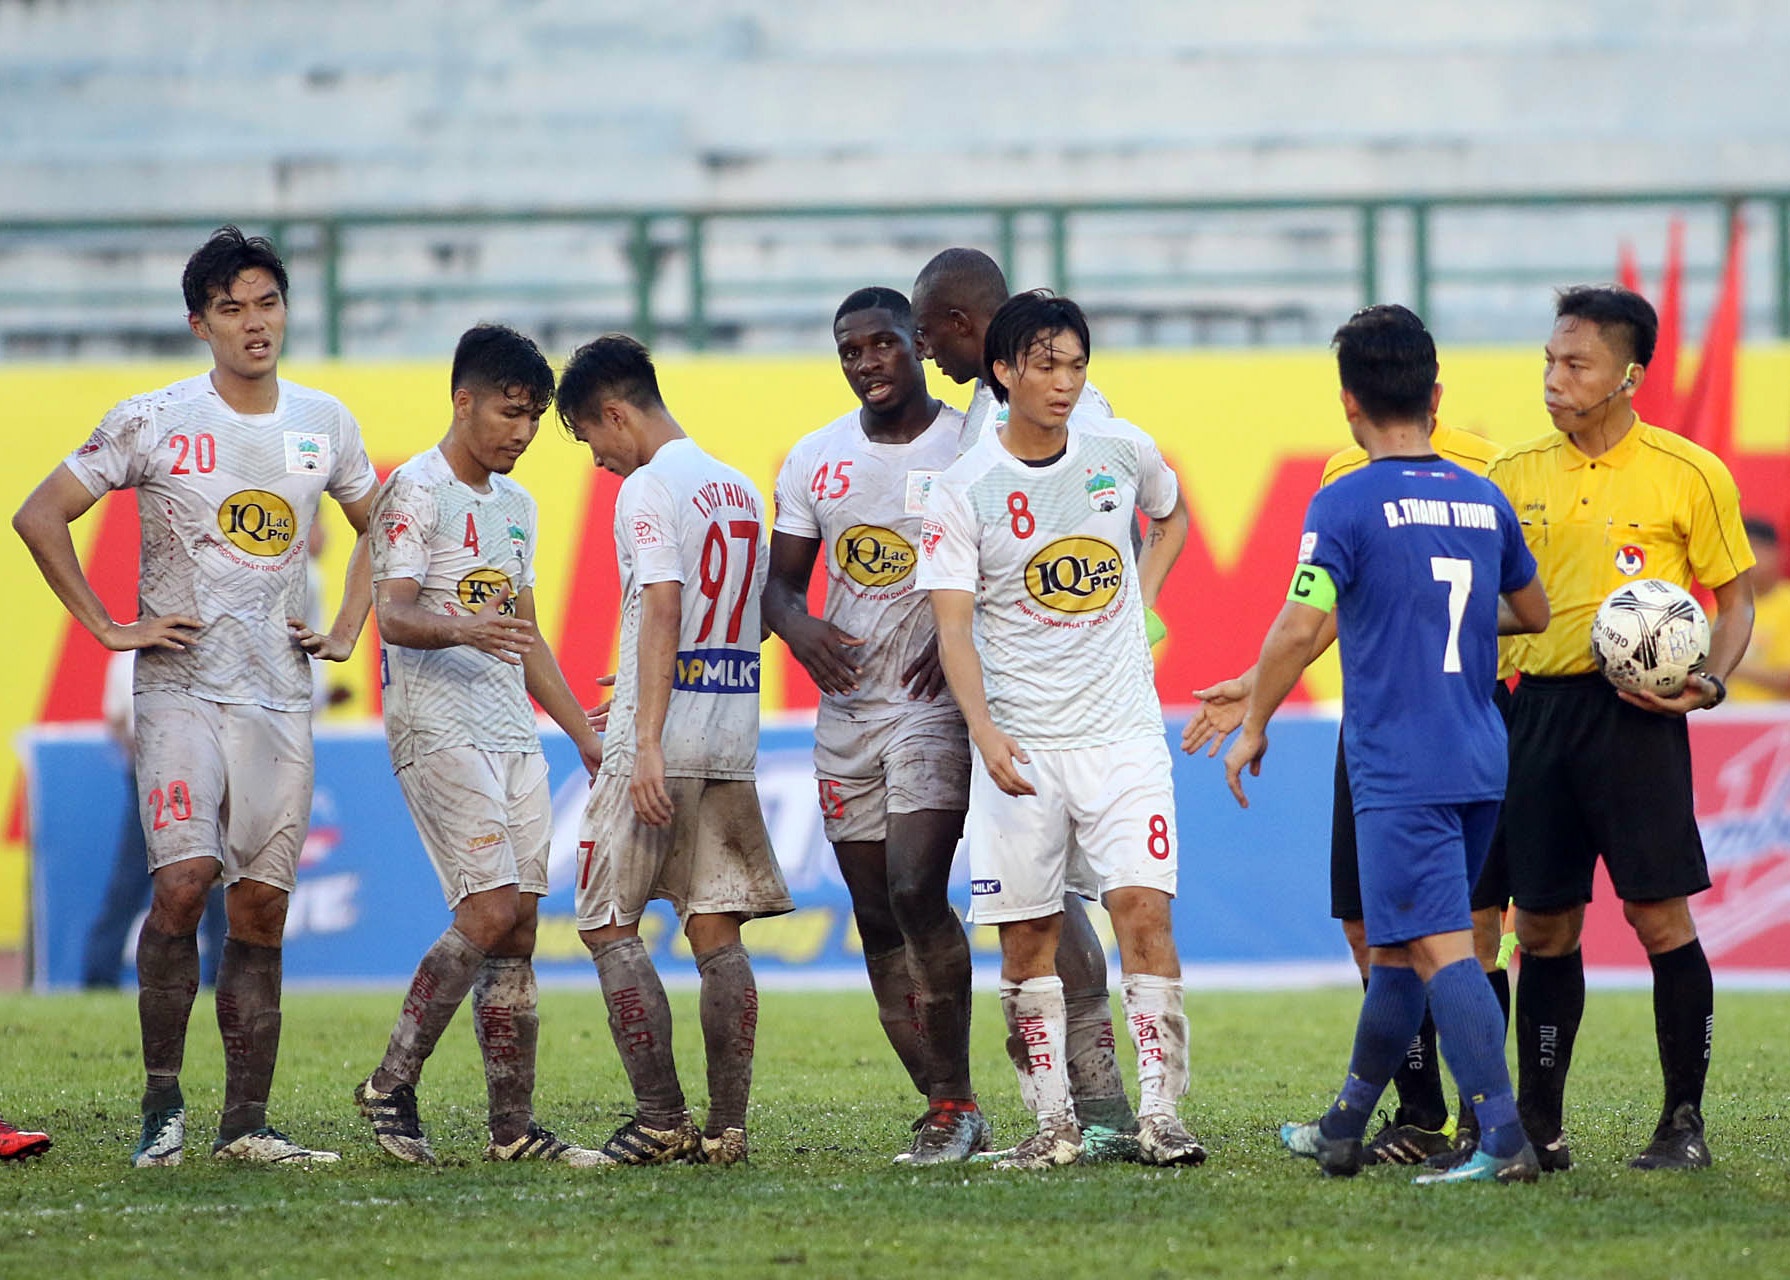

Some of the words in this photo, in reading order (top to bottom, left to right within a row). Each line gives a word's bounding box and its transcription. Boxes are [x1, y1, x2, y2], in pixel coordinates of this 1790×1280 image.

[169, 432, 216, 474] 20
[811, 461, 852, 500] 45
[228, 503, 268, 541] IQ
[266, 512, 289, 528] Lac
[1007, 491, 1035, 539] 8
[267, 529, 290, 541] Pro
[463, 512, 479, 557] 4
[845, 537, 880, 574] IQ
[880, 545, 909, 561] Lac
[693, 520, 759, 643] 97
[1035, 555, 1090, 596] IQ
[1080, 558, 1117, 577] Lac
[1091, 575, 1119, 591] Pro
[1294, 571, 1315, 597] C
[1430, 557, 1472, 673] 7
[148, 780, 192, 831] 20
[1148, 814, 1170, 860] 8
[611, 987, 648, 1031] HAGL
[626, 1031, 654, 1054] FC
[1016, 1016, 1050, 1049] HAGL
[1131, 1012, 1159, 1047] HAGL
[1539, 1025, 1557, 1067] mitre
[1028, 1053, 1052, 1076] FC
[1141, 1047, 1163, 1067] FC
[1407, 1035, 1425, 1070] mitre
